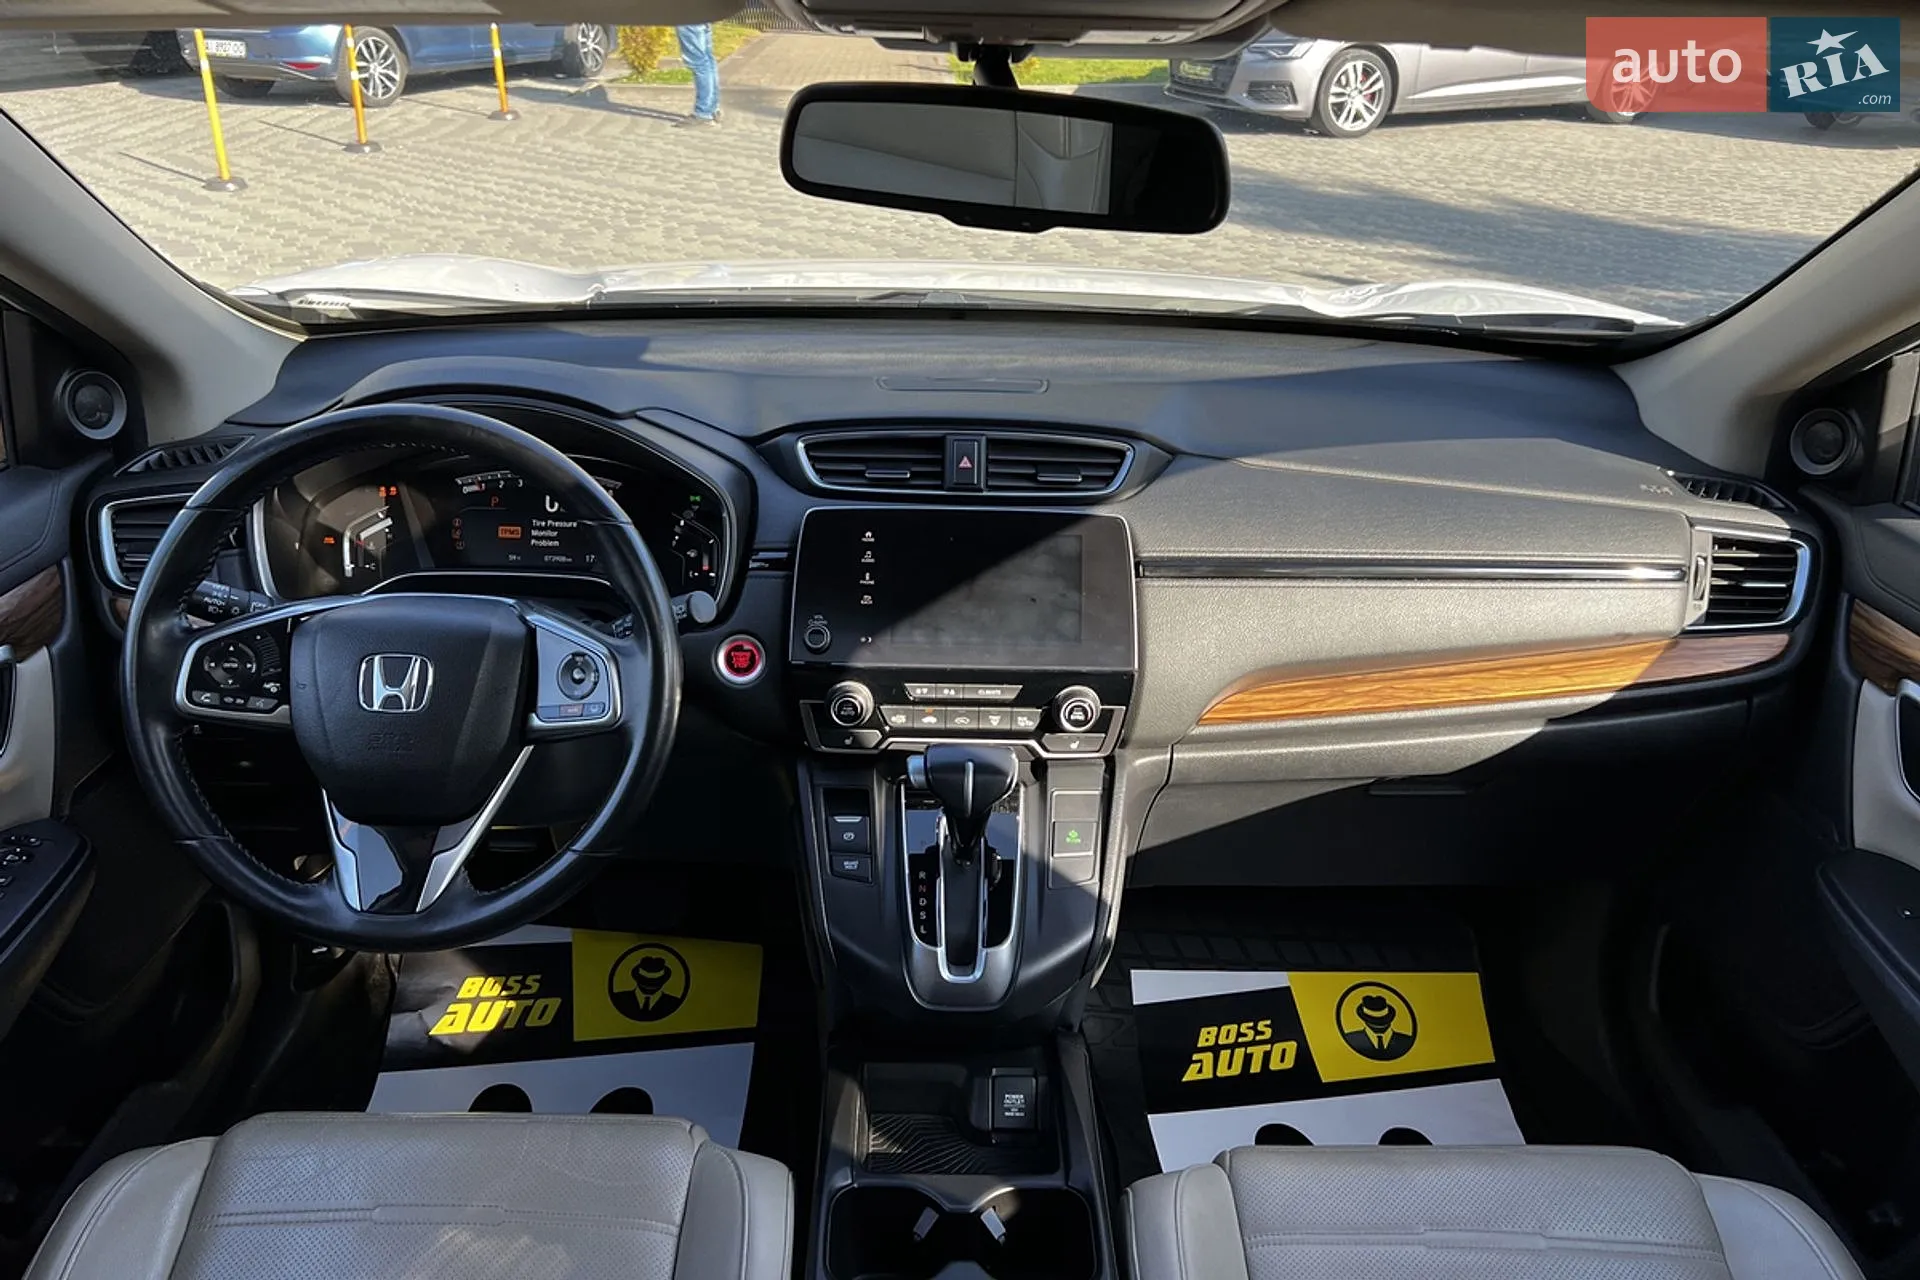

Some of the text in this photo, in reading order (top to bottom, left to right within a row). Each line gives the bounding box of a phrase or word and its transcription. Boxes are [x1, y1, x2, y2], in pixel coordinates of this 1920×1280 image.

[491, 496, 499, 507] P
[532, 519, 578, 528] Tire Pressure
[531, 529, 558, 538] Monitor
[531, 539, 560, 548] Problem
[918, 870, 926, 880] R
[918, 884, 927, 893] N
[919, 897, 927, 906] D
[919, 910, 927, 920] S
[919, 924, 927, 934] L
[456, 974, 542, 1000] BOSS
[428, 997, 562, 1036] AUTO
[1197, 1019, 1272, 1048] BOSS
[1180, 1040, 1298, 1082] AUTO
